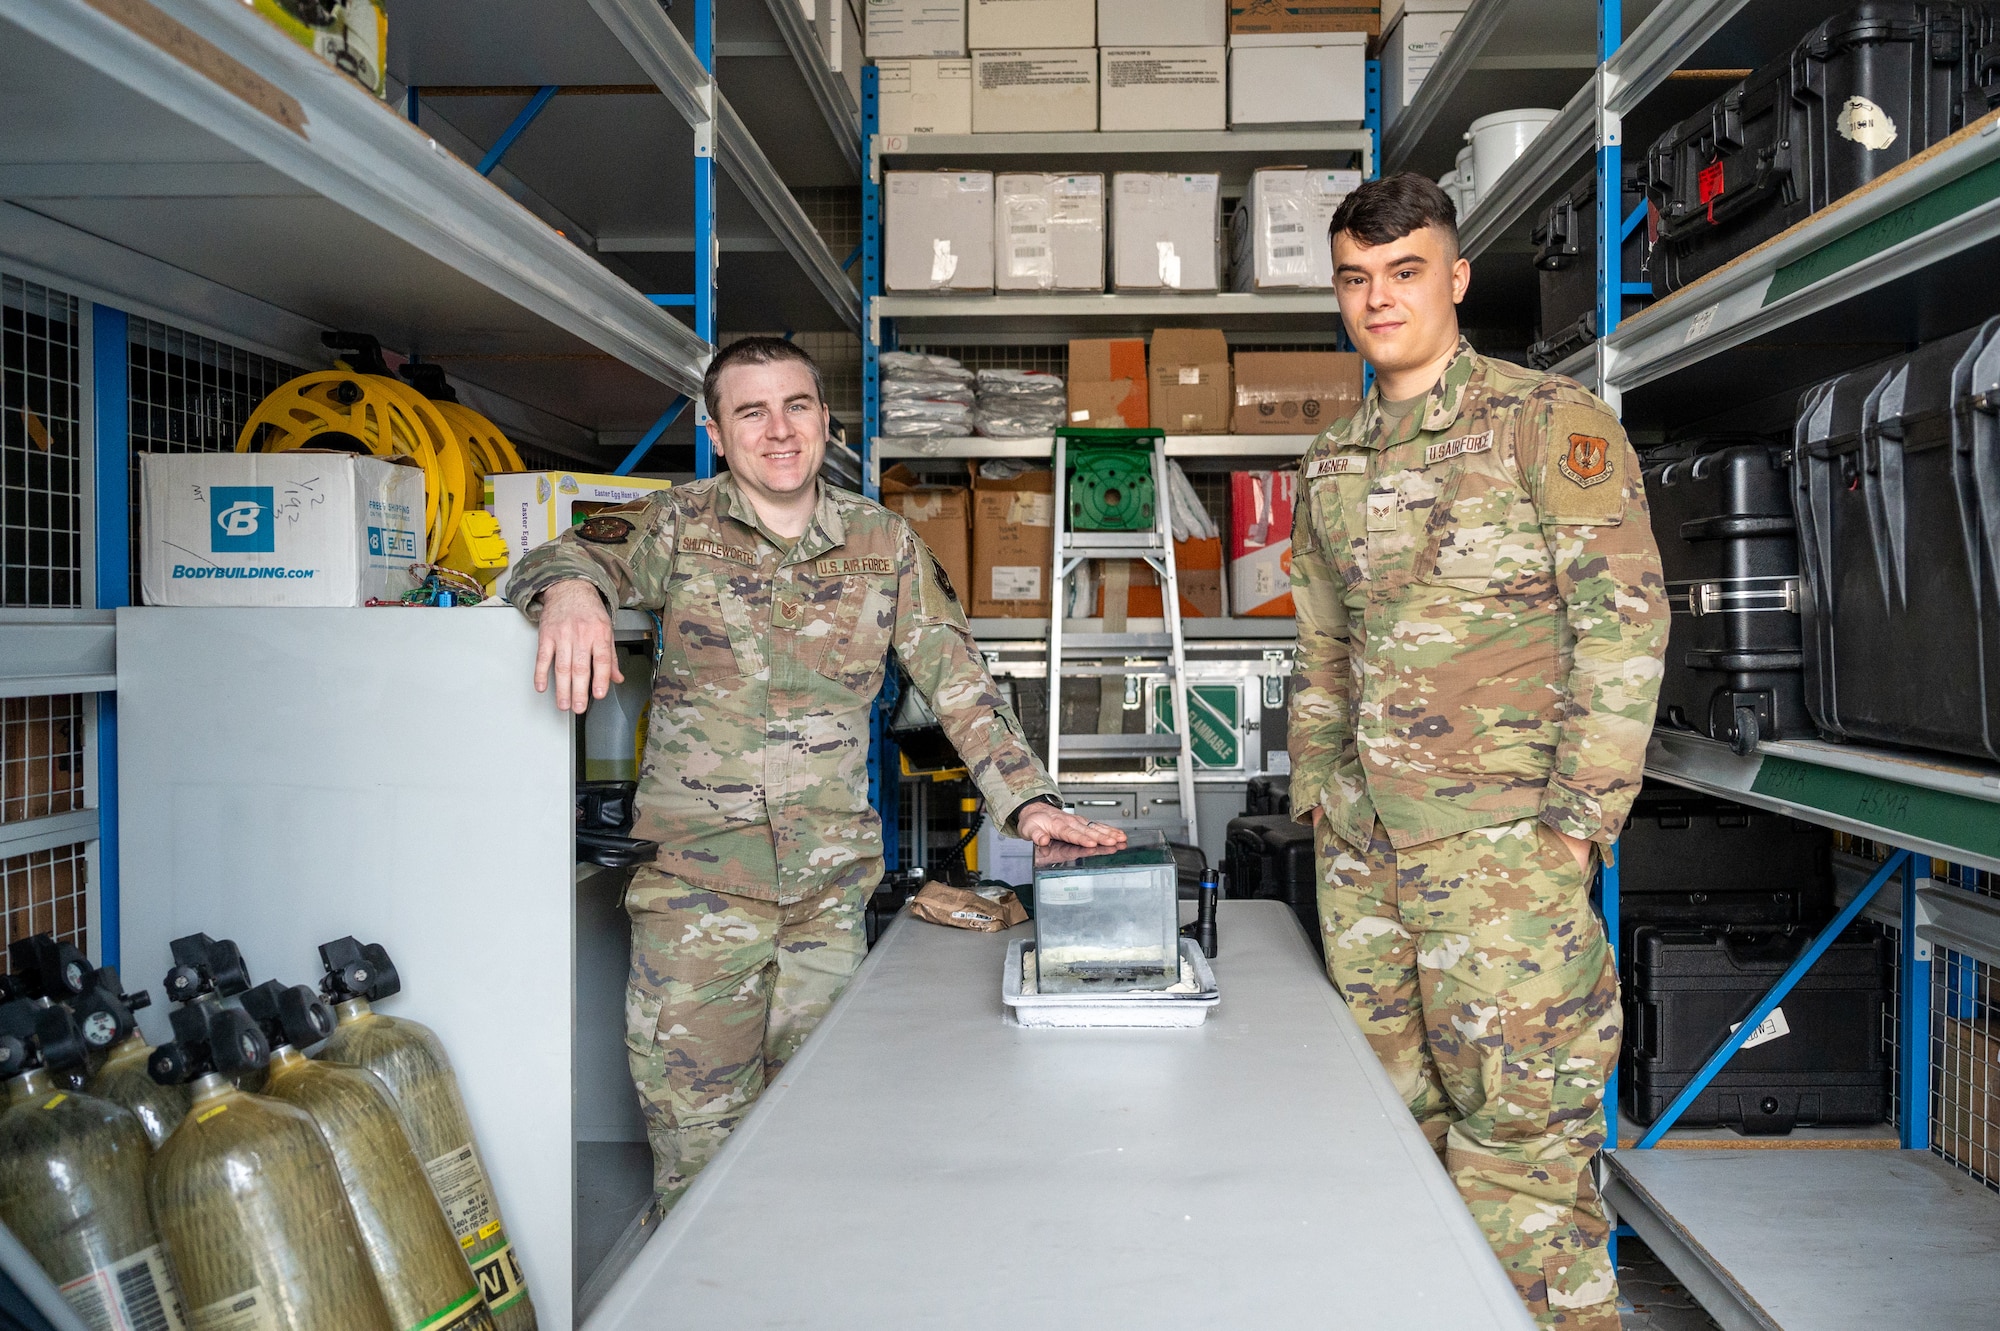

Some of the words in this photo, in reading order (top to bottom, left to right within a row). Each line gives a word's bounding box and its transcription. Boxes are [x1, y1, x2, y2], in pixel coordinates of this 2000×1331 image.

[886, 136, 902, 151] 10
[1317, 458, 1348, 474] WAGNER
[594, 489, 610, 497] Easter
[611, 490, 621, 499] Egg
[388, 537, 413, 551] ELITE
[682, 538, 753, 566] SHUTTLEWORTH
[172, 565, 313, 579] BODYBUILDING.COM
[820, 560, 840, 574] U.S.
[843, 560, 860, 573] AIR
[862, 558, 890, 572] FORCE
[468, 1207, 489, 1222] DOT-SP
[453, 1219, 468, 1230] 1091
